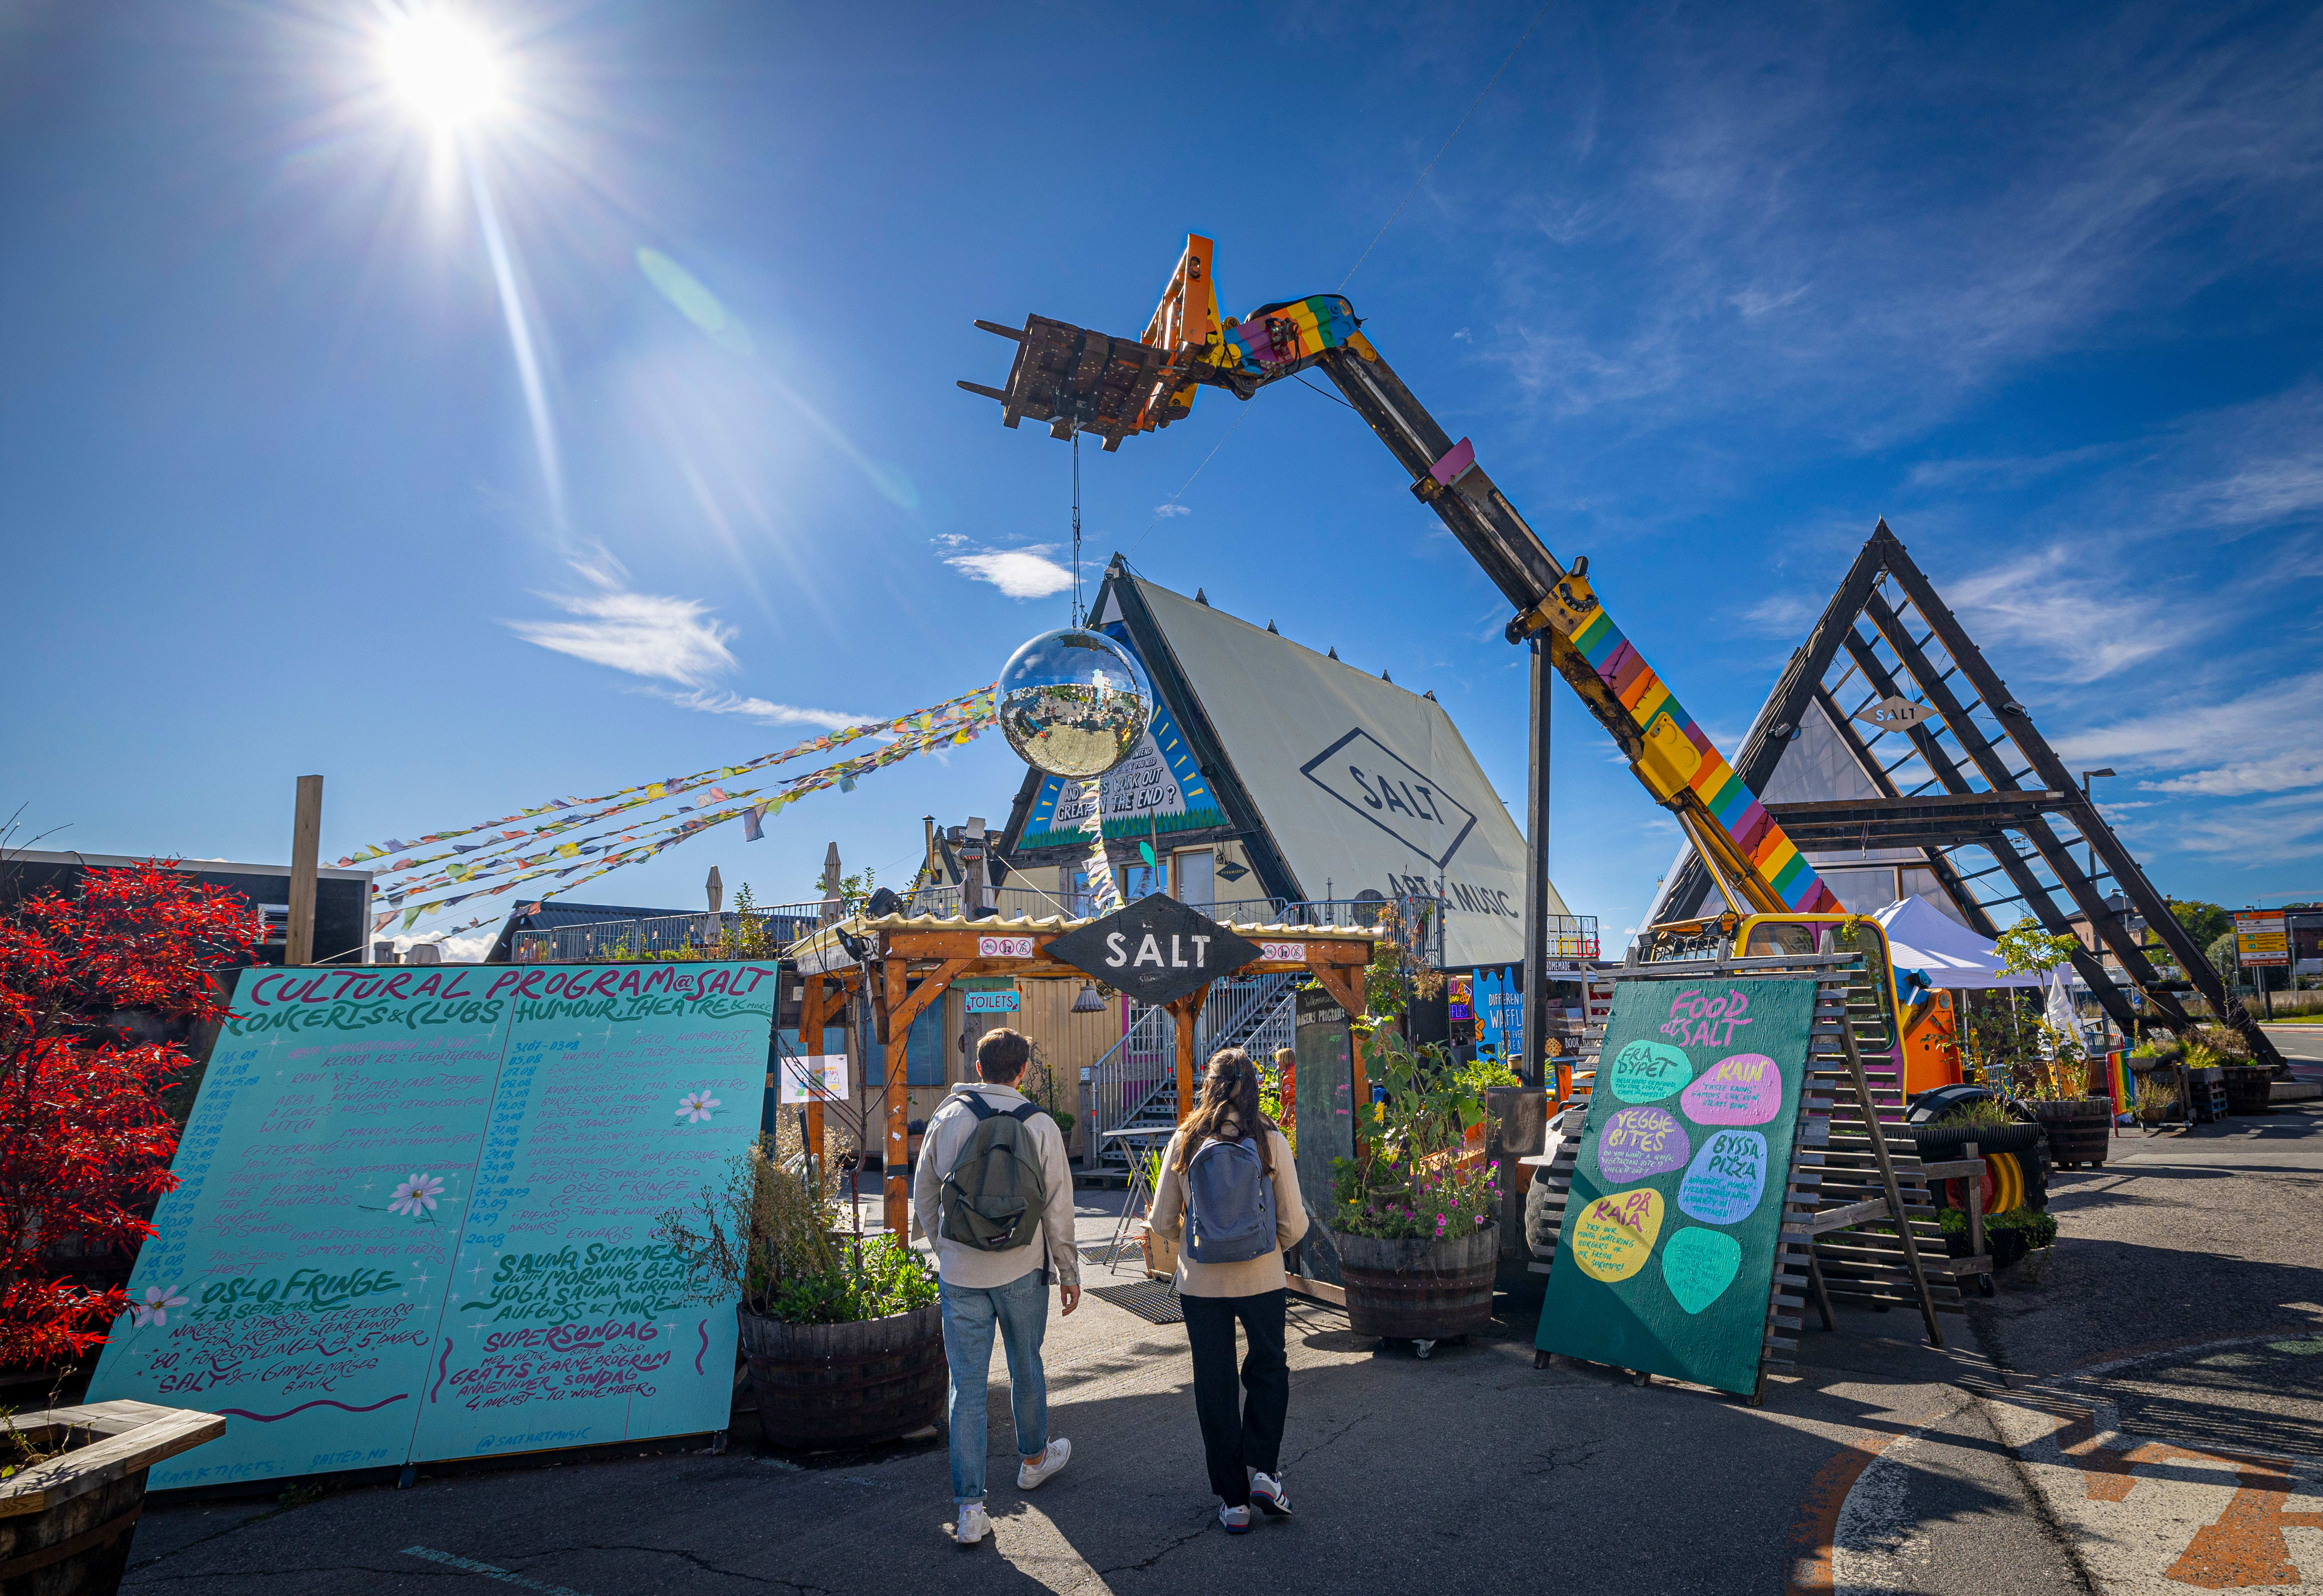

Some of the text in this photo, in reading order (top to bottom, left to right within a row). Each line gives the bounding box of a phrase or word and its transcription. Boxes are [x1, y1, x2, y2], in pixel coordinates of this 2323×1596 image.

[1876, 707, 1917, 722] SALT
[1132, 747, 1152, 758] INTEND
[1135, 759, 1145, 769] YOU
[1144, 757, 1156, 767] NEED
[1064, 787, 1080, 802] AND
[1142, 767, 1163, 786] OUT
[1112, 792, 1134, 813] THE
[1349, 766, 1445, 825] SALT
[1451, 882, 1519, 918] MUSIC
[1547, 917, 1599, 937] ELGIAN
[1105, 932, 1210, 968] SALT
[1549, 938, 1601, 957] AFFLES
[251, 970, 470, 1006] CULTURAL
[626, 992, 729, 1019] THEATRE
[970, 995, 1013, 1009] TOILETS
[1670, 989, 1749, 1019] FOOD
[1296, 1011, 1316, 1027] DAGENS
[630, 1030, 754, 1045] OSLO HUMORFEST
[1660, 1016, 1753, 1047] at SALT
[561, 1042, 756, 1062] HUMOR MED VENNER
[1565, 1037, 1579, 1049] BOOK
[1621, 1047, 1652, 1063] FRA
[546, 1057, 704, 1075] ENGLISH STANDUP OSLO
[1617, 1057, 1679, 1078] DYPET
[1717, 1060, 1769, 1083] KAIN
[290, 1072, 327, 1084] RAVI
[402, 1076, 437, 1088] CARL
[642, 1081, 668, 1091] MID
[275, 1089, 401, 1106] ABBA KNIGHTS
[540, 1091, 660, 1110] BURLESQUE BINGO
[341, 1102, 392, 1116] HOLIDAY
[536, 1107, 592, 1119] NESTEN
[259, 1119, 316, 1134] WITCH
[341, 1121, 445, 1138] MALVIN GURO
[574, 1117, 633, 1130] STANDUP
[637, 1125, 754, 1138] HOT DRAG SUMMER
[1617, 1110, 1675, 1133] VEGGIE
[398, 1131, 481, 1148] MINIKONSERT
[1608, 1128, 1665, 1152] BITES
[1713, 1134, 1759, 1159] BYSSA
[228, 1159, 271, 1174] JON
[640, 1150, 722, 1165] BURLESQUE
[1708, 1155, 1756, 1180] PIZZA
[291, 1167, 326, 1181] DAYS
[526, 1166, 700, 1184] ENGLISH STANDUP OSLO
[222, 1181, 338, 1201] ANE BJERKAN
[562, 1180, 690, 1195] OSLO FRINGE
[216, 1194, 353, 1210] THE LIONHEADS
[1625, 1191, 1652, 1217] PÅ
[511, 1205, 665, 1223] FRIENDS WHERE
[1592, 1200, 1643, 1233] KAIA
[288, 1226, 448, 1243] UNDERTAKERS CIRCUS
[507, 1221, 558, 1235] DRINKS
[566, 1225, 633, 1244] EINARS
[1598, 1234, 1635, 1248] WATERING
[296, 1241, 448, 1264] SUMMER BLOCK PARTY
[493, 1243, 707, 1283] SAUNA SUMMER
[541, 1261, 642, 1287] MORNING
[201, 1267, 405, 1307] OSLO FRINGE
[553, 1281, 621, 1305] SAUNA
[234, 1299, 351, 1319] SEPTEMBER
[492, 1302, 587, 1326] AUFGUSS
[168, 1303, 415, 1341] NORGES STØRSTE LEKEPLASS
[201, 1317, 408, 1349] FOR KREATIV SCENEKUNST
[482, 1319, 658, 1353] SUPERSØNDAG
[149, 1330, 429, 1372] 80 FORESTILLINGER PÅ 5 DAGER
[480, 1343, 646, 1368] MED KULTUR GAMLE OSLO
[261, 1357, 379, 1382] GAMLE NORGES
[449, 1350, 672, 1386] GRATIS BARNEPROGRAM
[281, 1375, 337, 1396] BANK
[455, 1367, 638, 1399] ANNENHVER SØNDAG
[482, 1381, 657, 1408] AUGUST NOVEMBER
